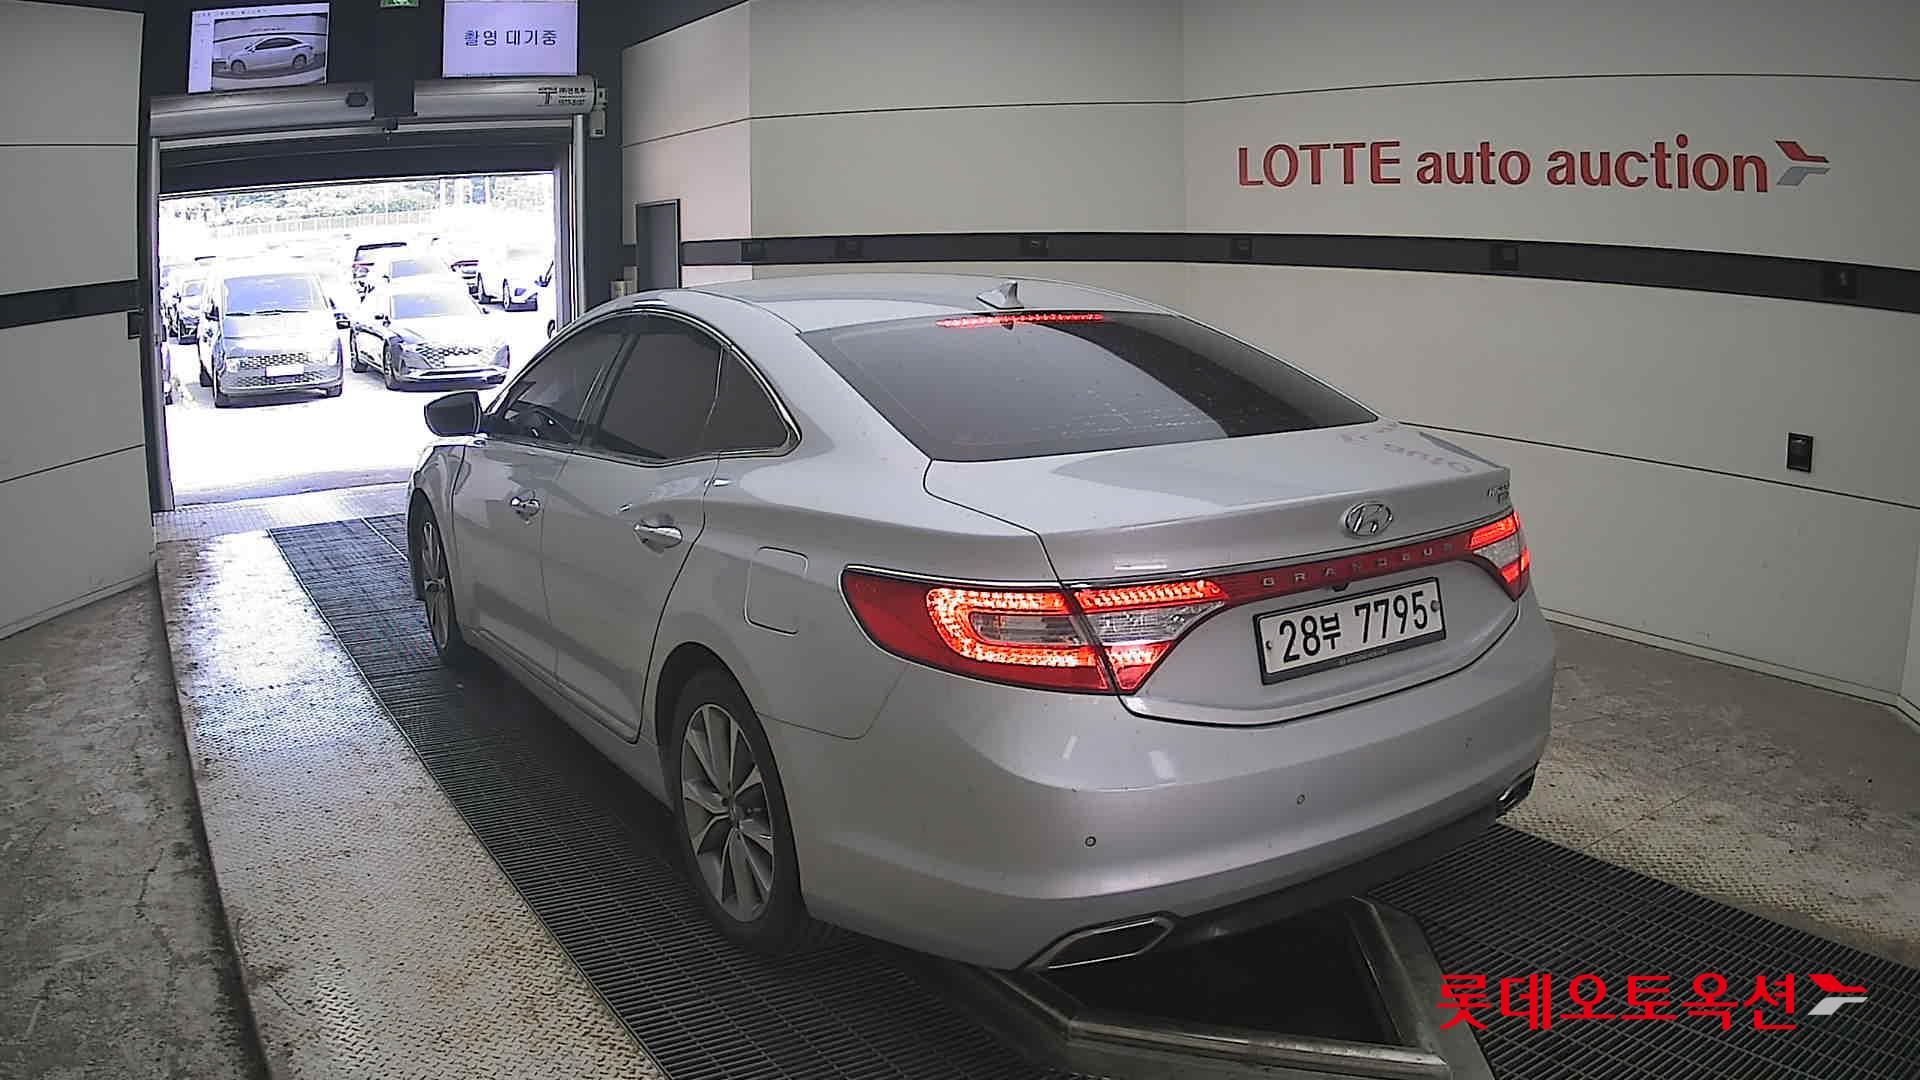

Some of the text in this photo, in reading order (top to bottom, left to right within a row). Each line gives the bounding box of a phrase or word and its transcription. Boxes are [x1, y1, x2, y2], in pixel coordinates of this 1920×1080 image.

[505, 29, 558, 46] 대기중
[1237, 134, 1769, 193] LOTTE auto auction
[1262, 543, 1453, 586] GRANU
[1278, 590, 1428, 664] 28부 7795
